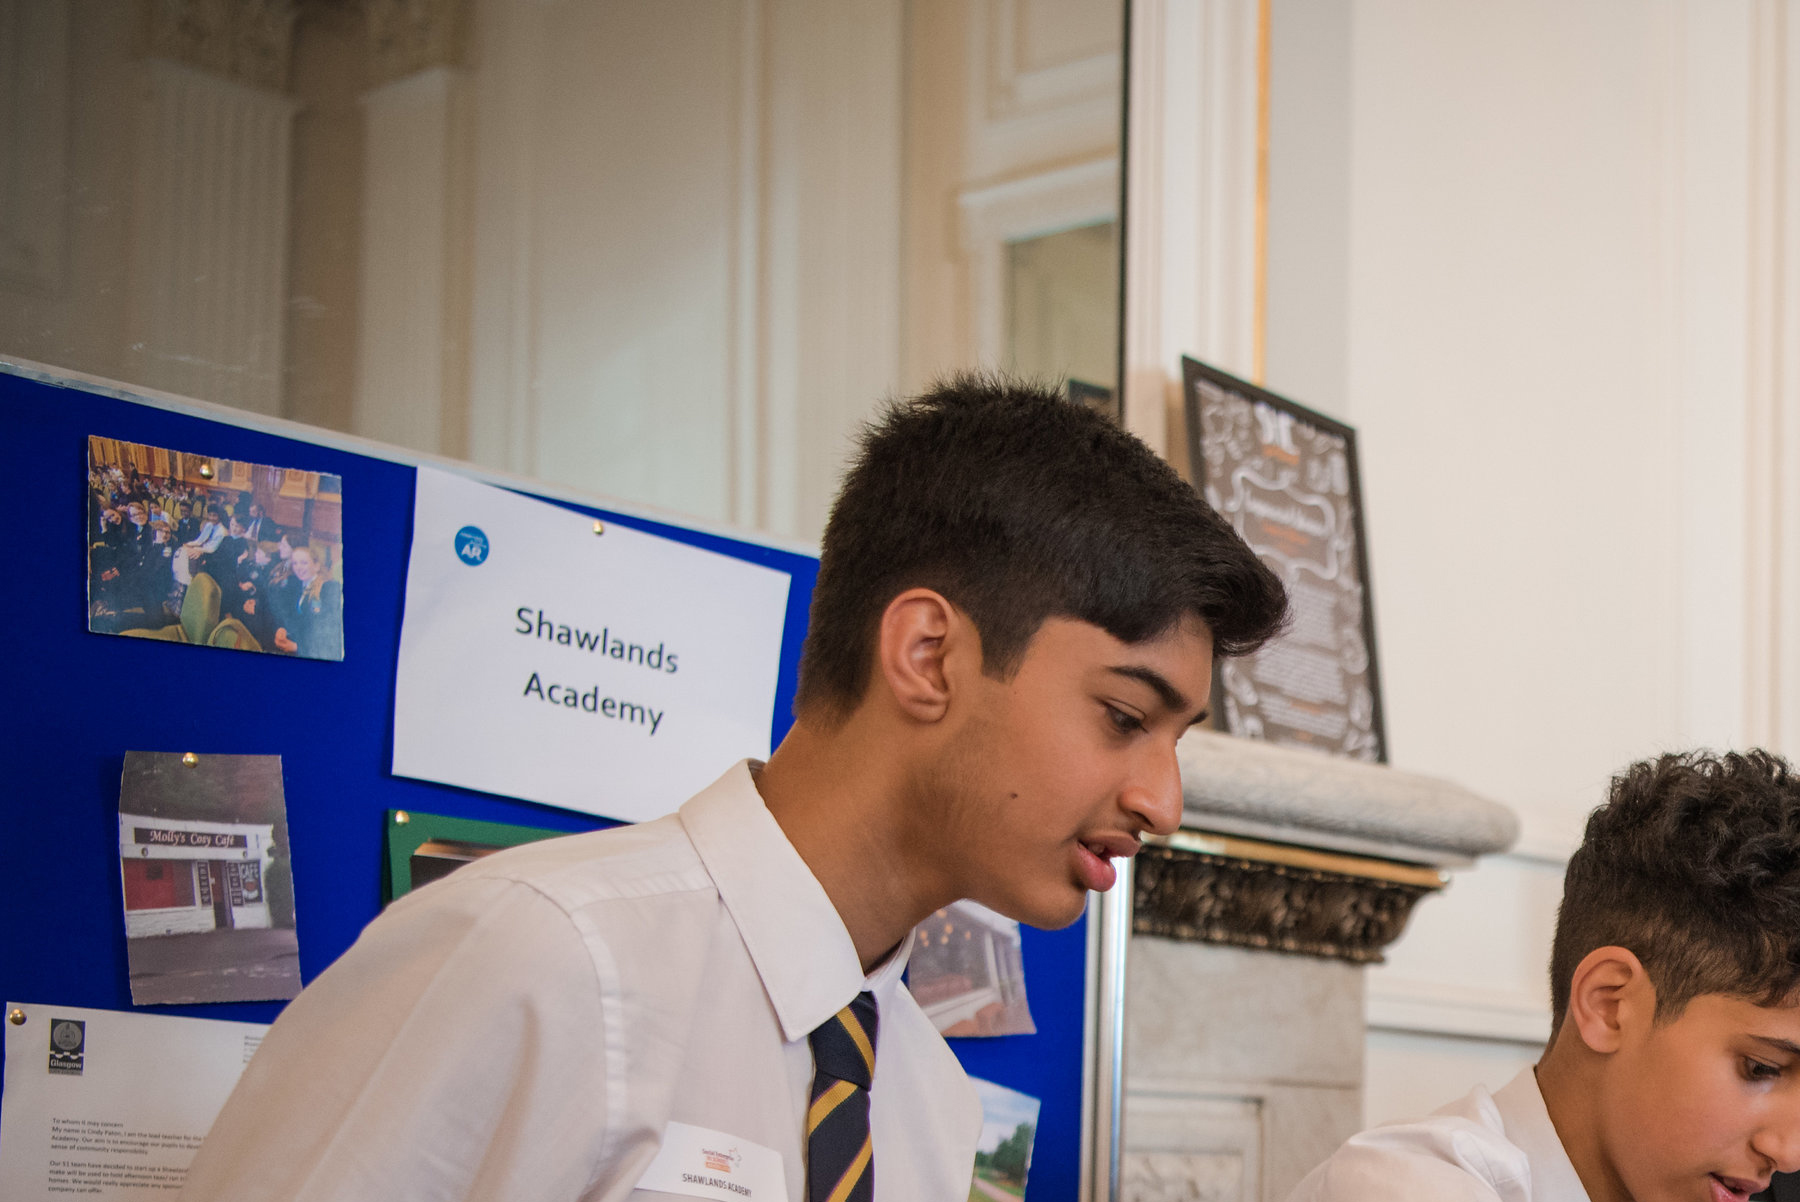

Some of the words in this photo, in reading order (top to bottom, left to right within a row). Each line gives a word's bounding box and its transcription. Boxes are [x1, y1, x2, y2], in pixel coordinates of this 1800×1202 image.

[516, 606, 679, 674] Shawlands
[523, 672, 664, 737] Academy
[150, 830, 185, 848] Molly's
[190, 832, 213, 848] Cosy
[50, 1059, 82, 1069] Glasgow
[682, 1173, 728, 1189] SHAWLANDS
[728, 1182, 752, 1197] ACADEMY
